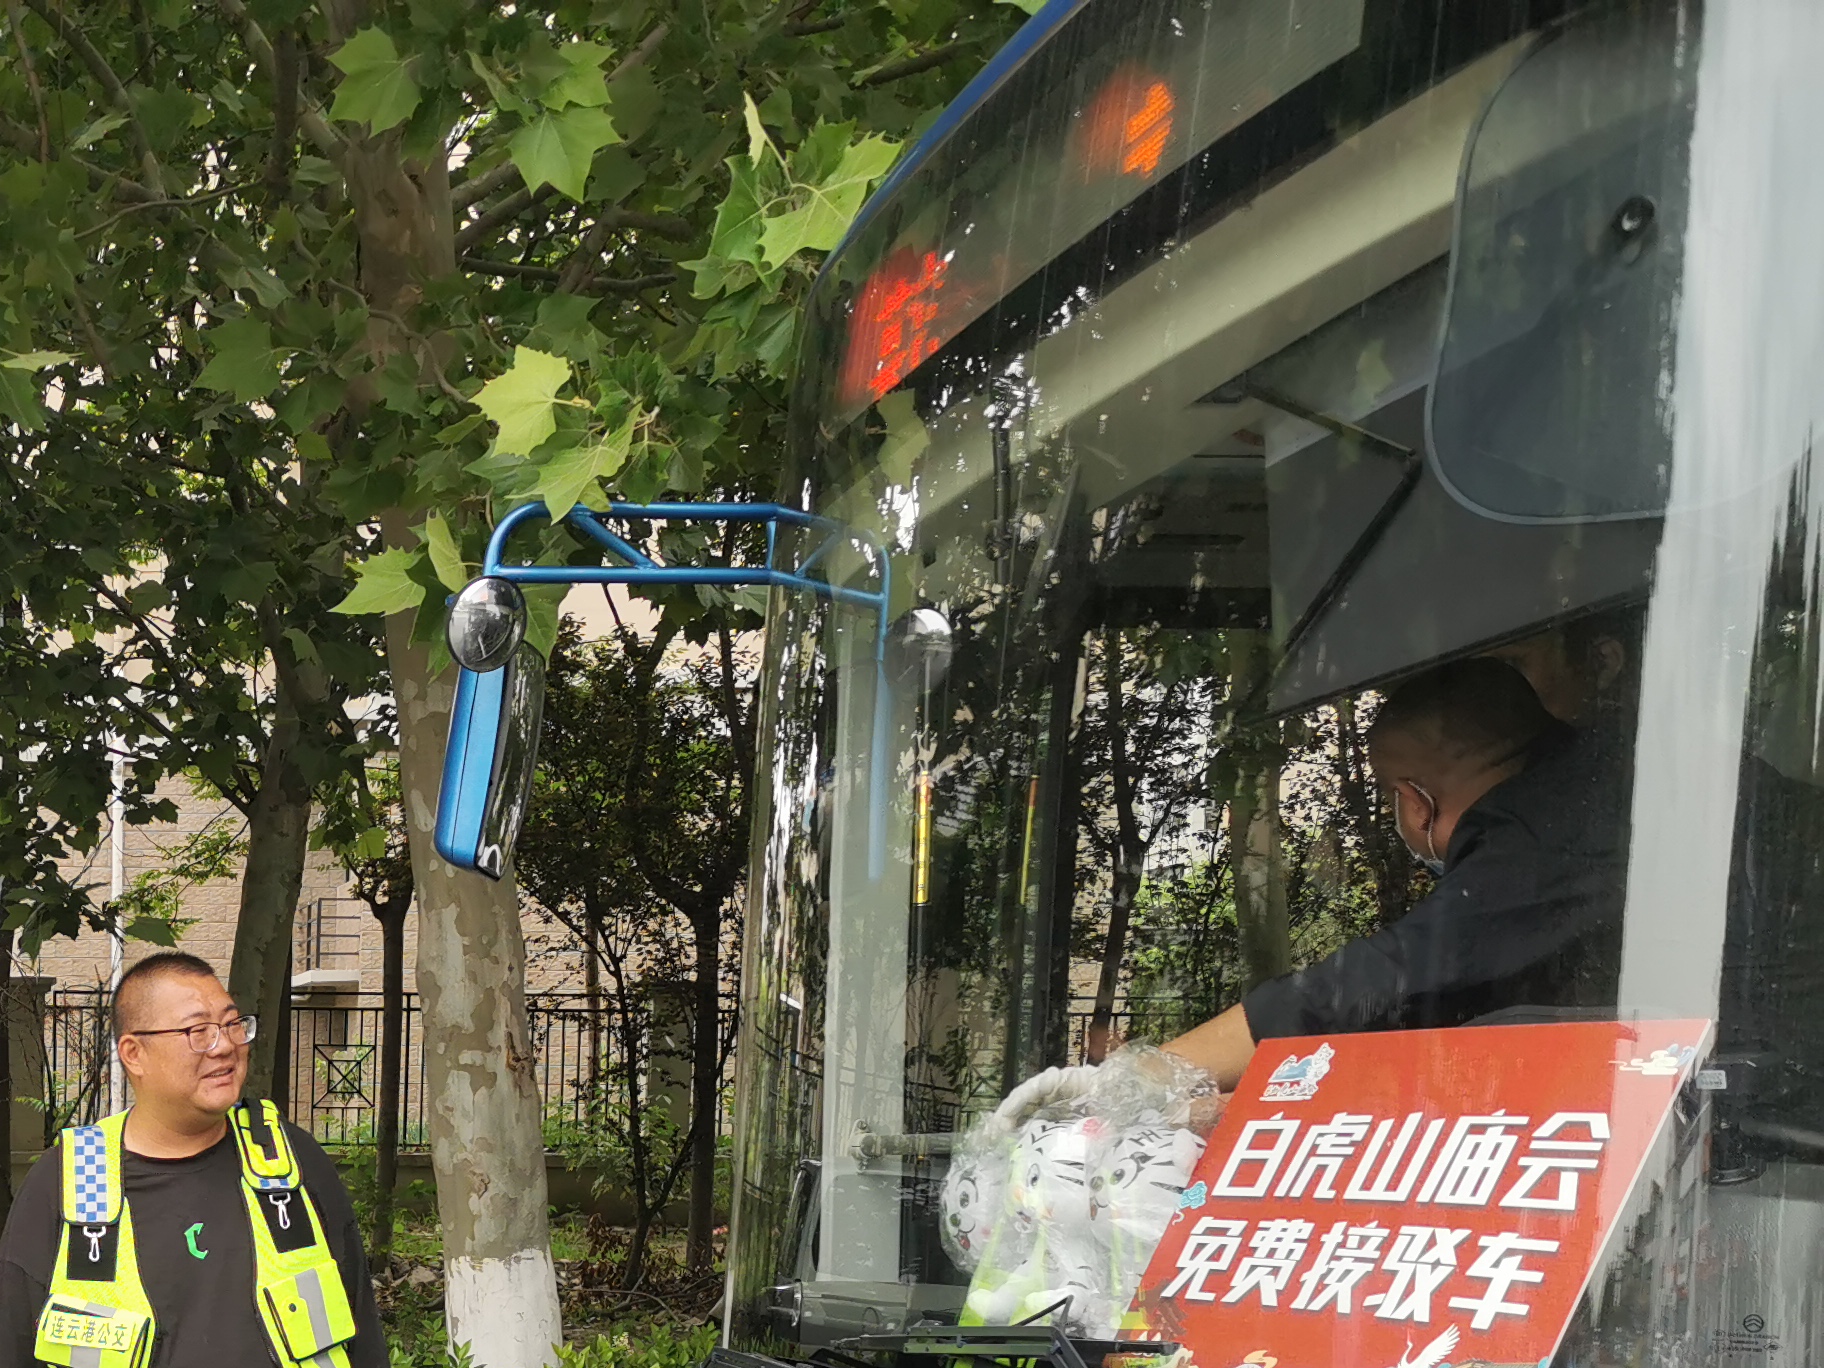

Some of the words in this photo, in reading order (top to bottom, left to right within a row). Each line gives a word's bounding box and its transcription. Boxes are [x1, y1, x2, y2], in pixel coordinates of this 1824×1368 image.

[1211, 1109, 1610, 1211] 白虎山庙会
[1161, 1216, 1560, 1330] 免费接驳车
[50, 1315, 128, 1346] 连云港公交
